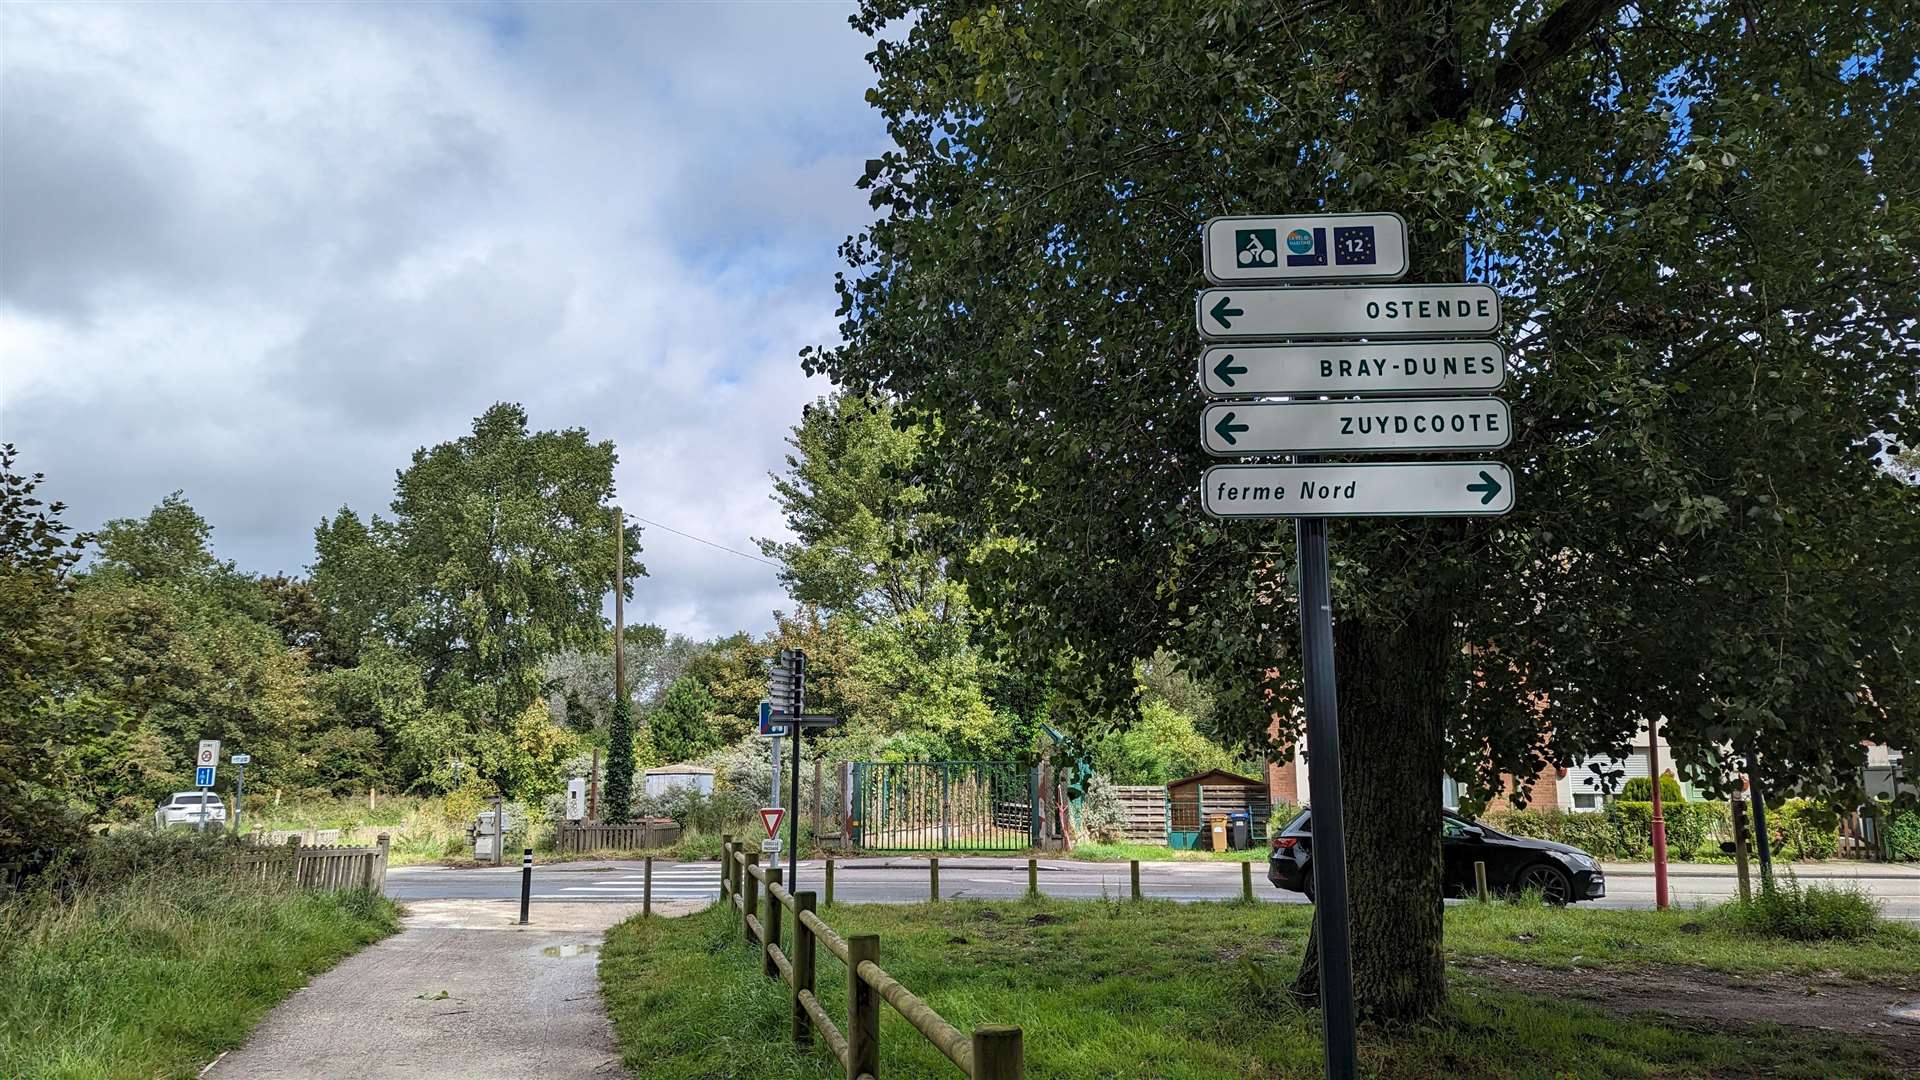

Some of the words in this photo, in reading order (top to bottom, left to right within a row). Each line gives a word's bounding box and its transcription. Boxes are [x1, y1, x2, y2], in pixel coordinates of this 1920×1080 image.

[1345, 239, 1364, 252] 12
[1366, 300, 1490, 319] OSTENDE
[1320, 356, 1495, 377] BRAY-DUNES
[1340, 413, 1499, 435] ZUYDCOOTE
[1217, 482, 1286, 500] ferme
[1300, 481, 1357, 500] Nord
